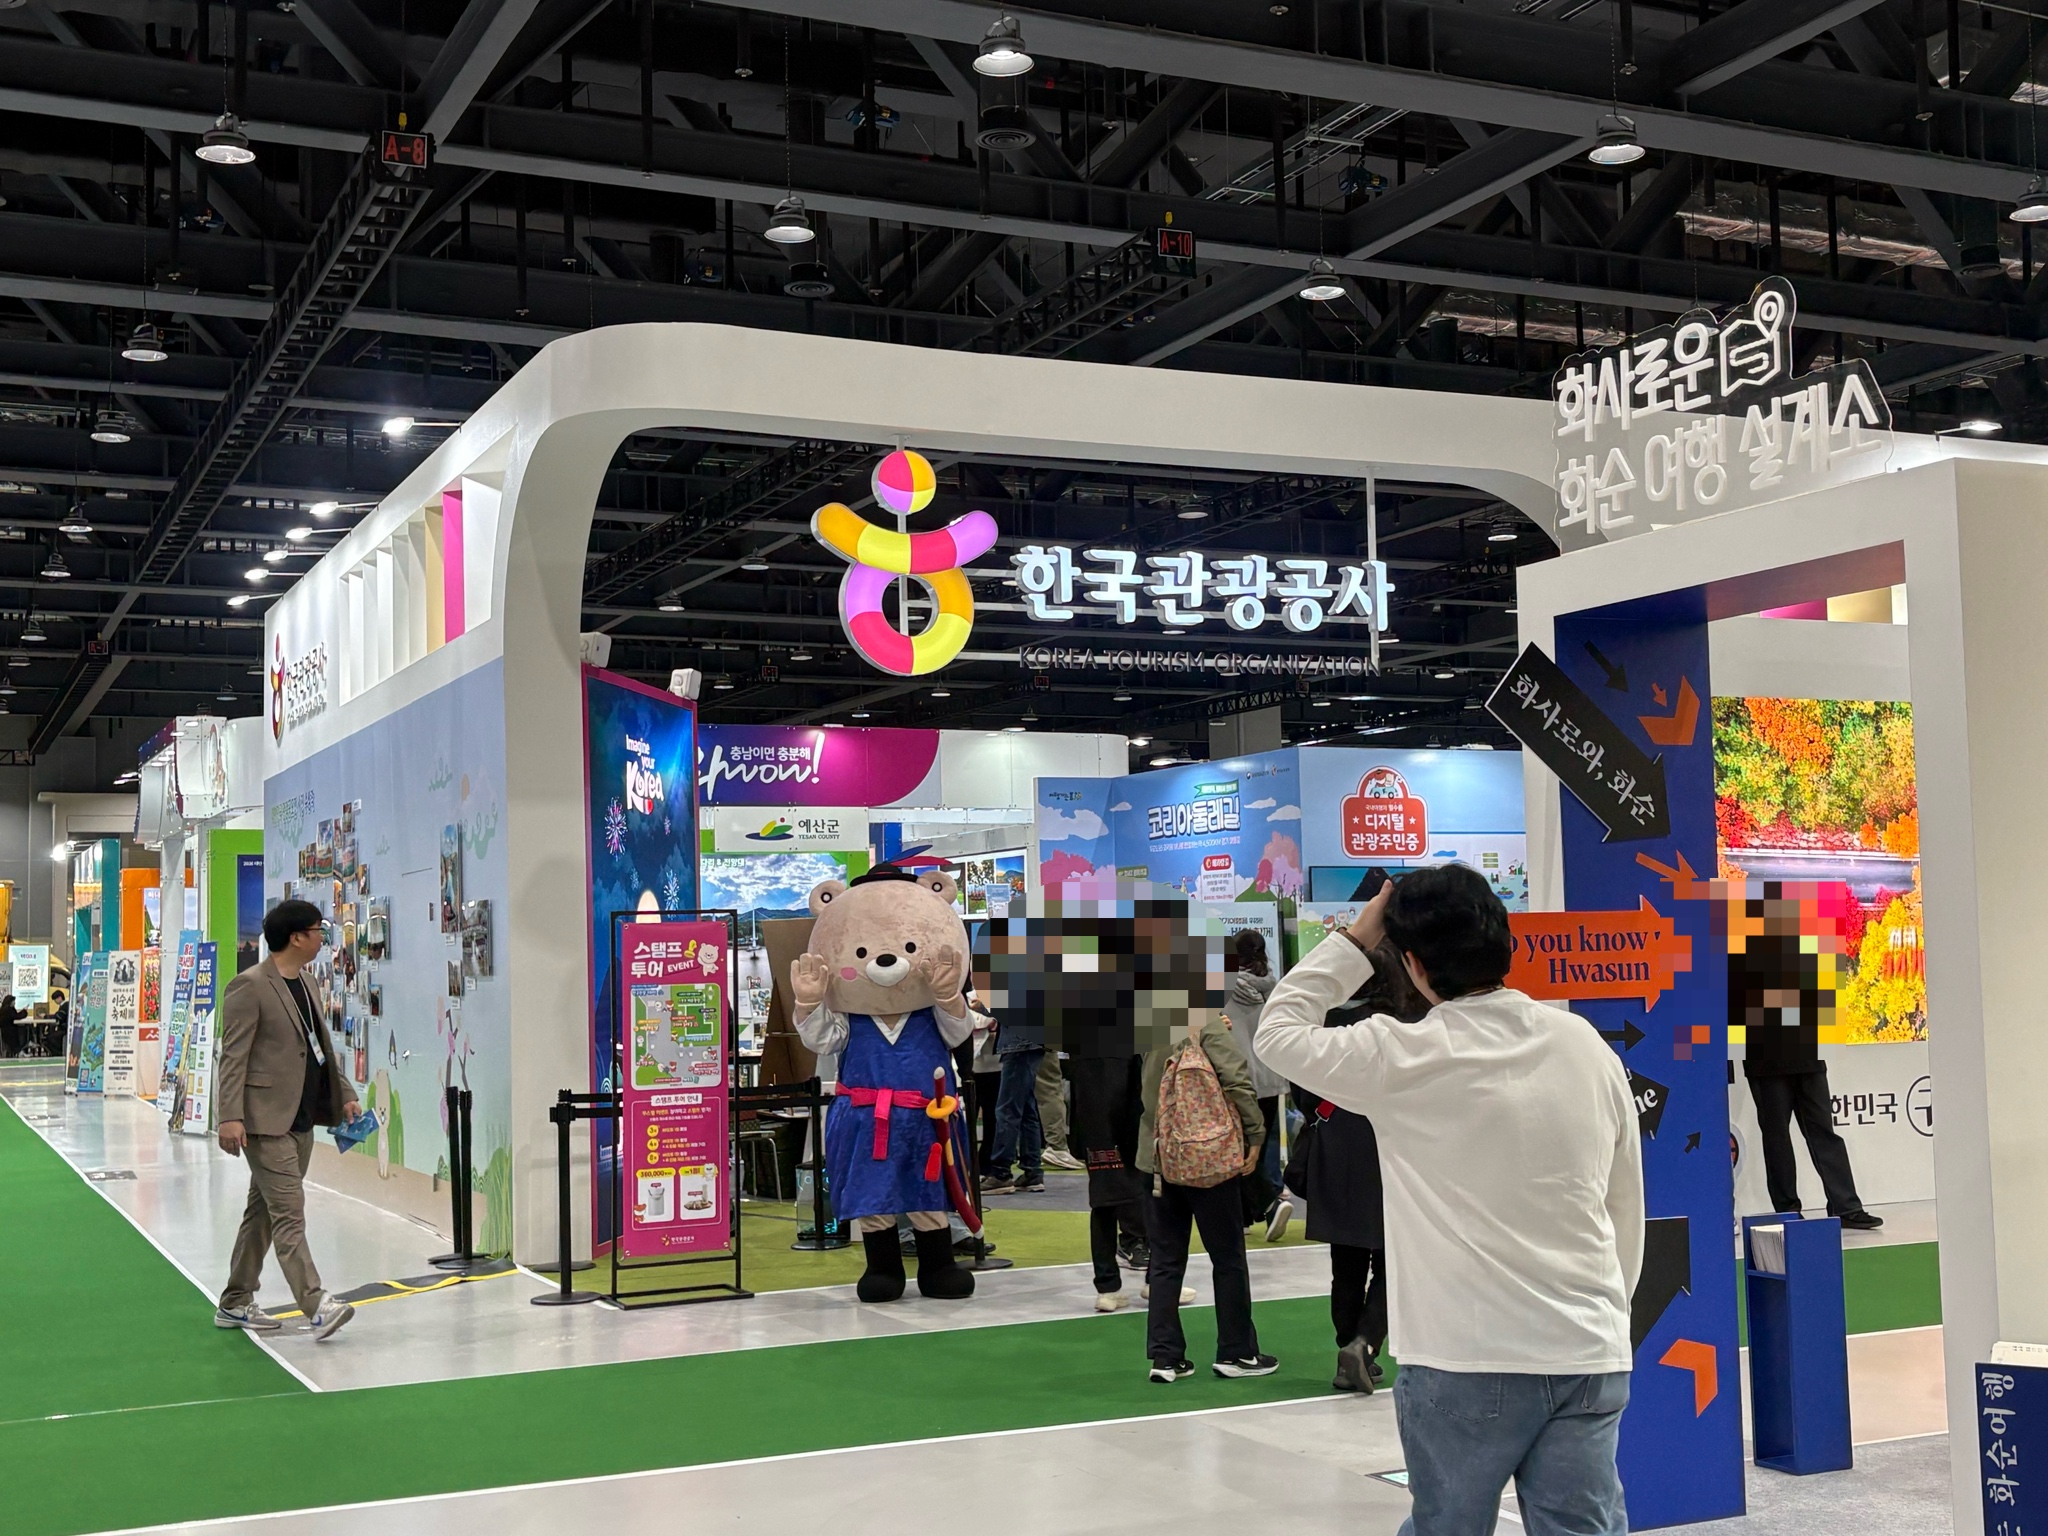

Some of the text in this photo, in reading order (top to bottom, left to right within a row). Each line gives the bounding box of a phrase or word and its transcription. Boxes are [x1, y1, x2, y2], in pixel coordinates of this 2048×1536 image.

[385, 135, 424, 165] A-8
[1161, 231, 1190, 256] A-10
[1557, 322, 1715, 442] 화사로운
[1559, 374, 1883, 534] 화순 여행 설계소
[1010, 544, 1396, 632] 한국관광공사
[1019, 646, 1381, 677] KOREA TOURISM ORGANIZATION
[1510, 673, 1605, 781] 화사로와,
[625, 734, 650, 756] Imagine
[730, 746, 811, 761] 충남이면 충분해
[641, 755, 655, 771] your
[626, 761, 664, 815] Korea
[1607, 769, 1655, 826] 화순
[798, 819, 840, 834] 예산군
[1148, 795, 1241, 840] 코리아둘레길
[1365, 813, 1405, 831] 디지털
[1351, 833, 1419, 851] 관광주민증
[634, 941, 683, 959] 스탬프
[1524, 932, 1572, 962] you
[1579, 925, 1648, 952] know
[197, 972, 212, 987] SNS
[631, 960, 694, 978] 투어 EVENT
[1549, 958, 1650, 984] Hwasun
[112, 994, 135, 1007] 이순신
[111, 1007, 128, 1021] 축제
[655, 1096, 672, 1104] 스탬프
